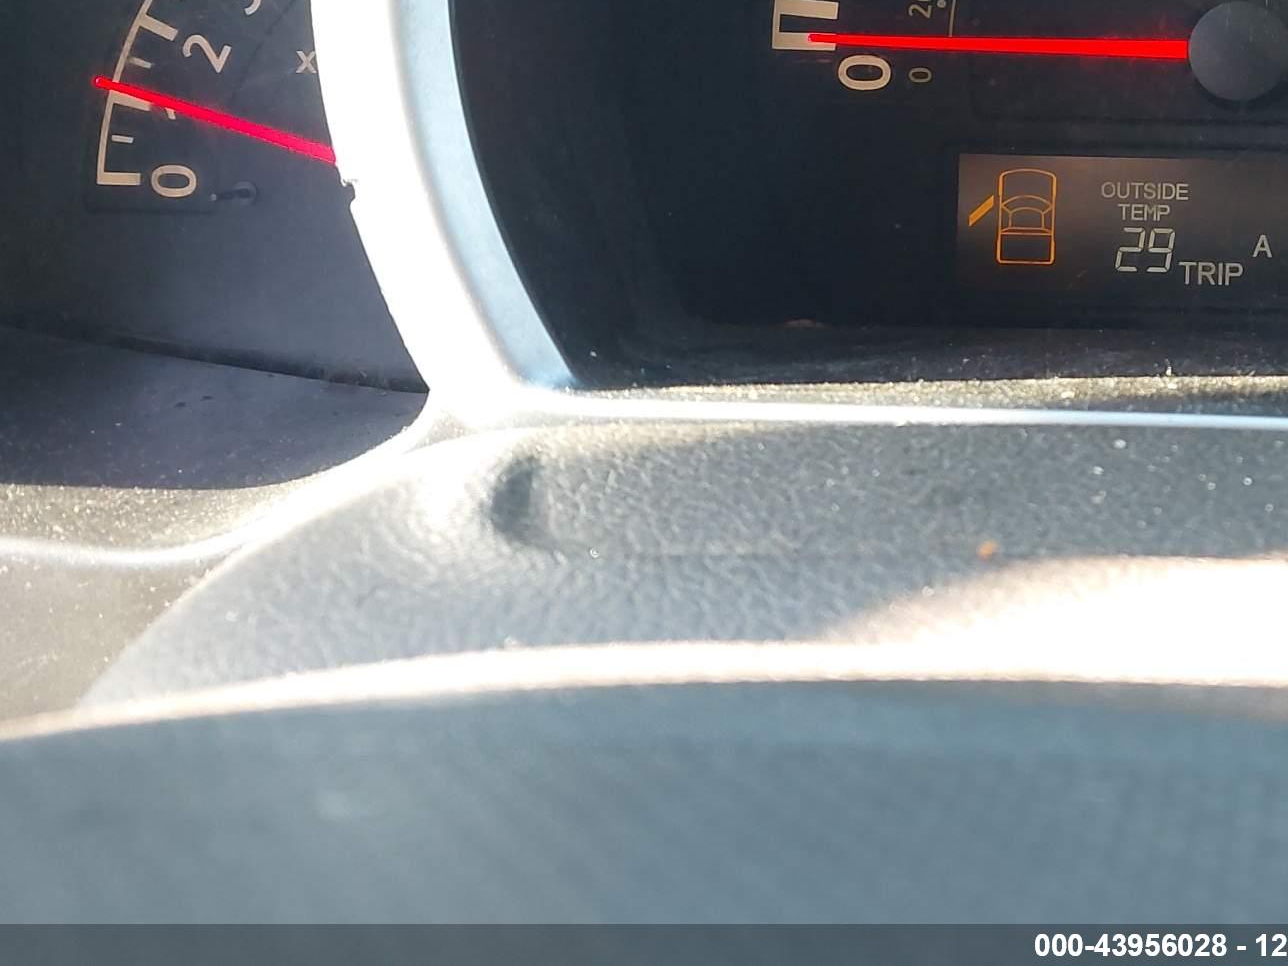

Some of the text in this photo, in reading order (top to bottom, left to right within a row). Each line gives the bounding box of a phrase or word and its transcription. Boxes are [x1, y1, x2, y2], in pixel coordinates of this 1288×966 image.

[182, 34, 232, 74] 2
[837, 54, 893, 92] 0
[908, 67, 933, 84] 0
[149, 163, 197, 198] 0
[1100, 181, 1190, 201] OUTSIDE
[1117, 203, 1171, 222] TEMP
[1114, 227, 1176, 273] 29
[1252, 235, 1273, 258] A
[1179, 261, 1244, 287] TRIP
